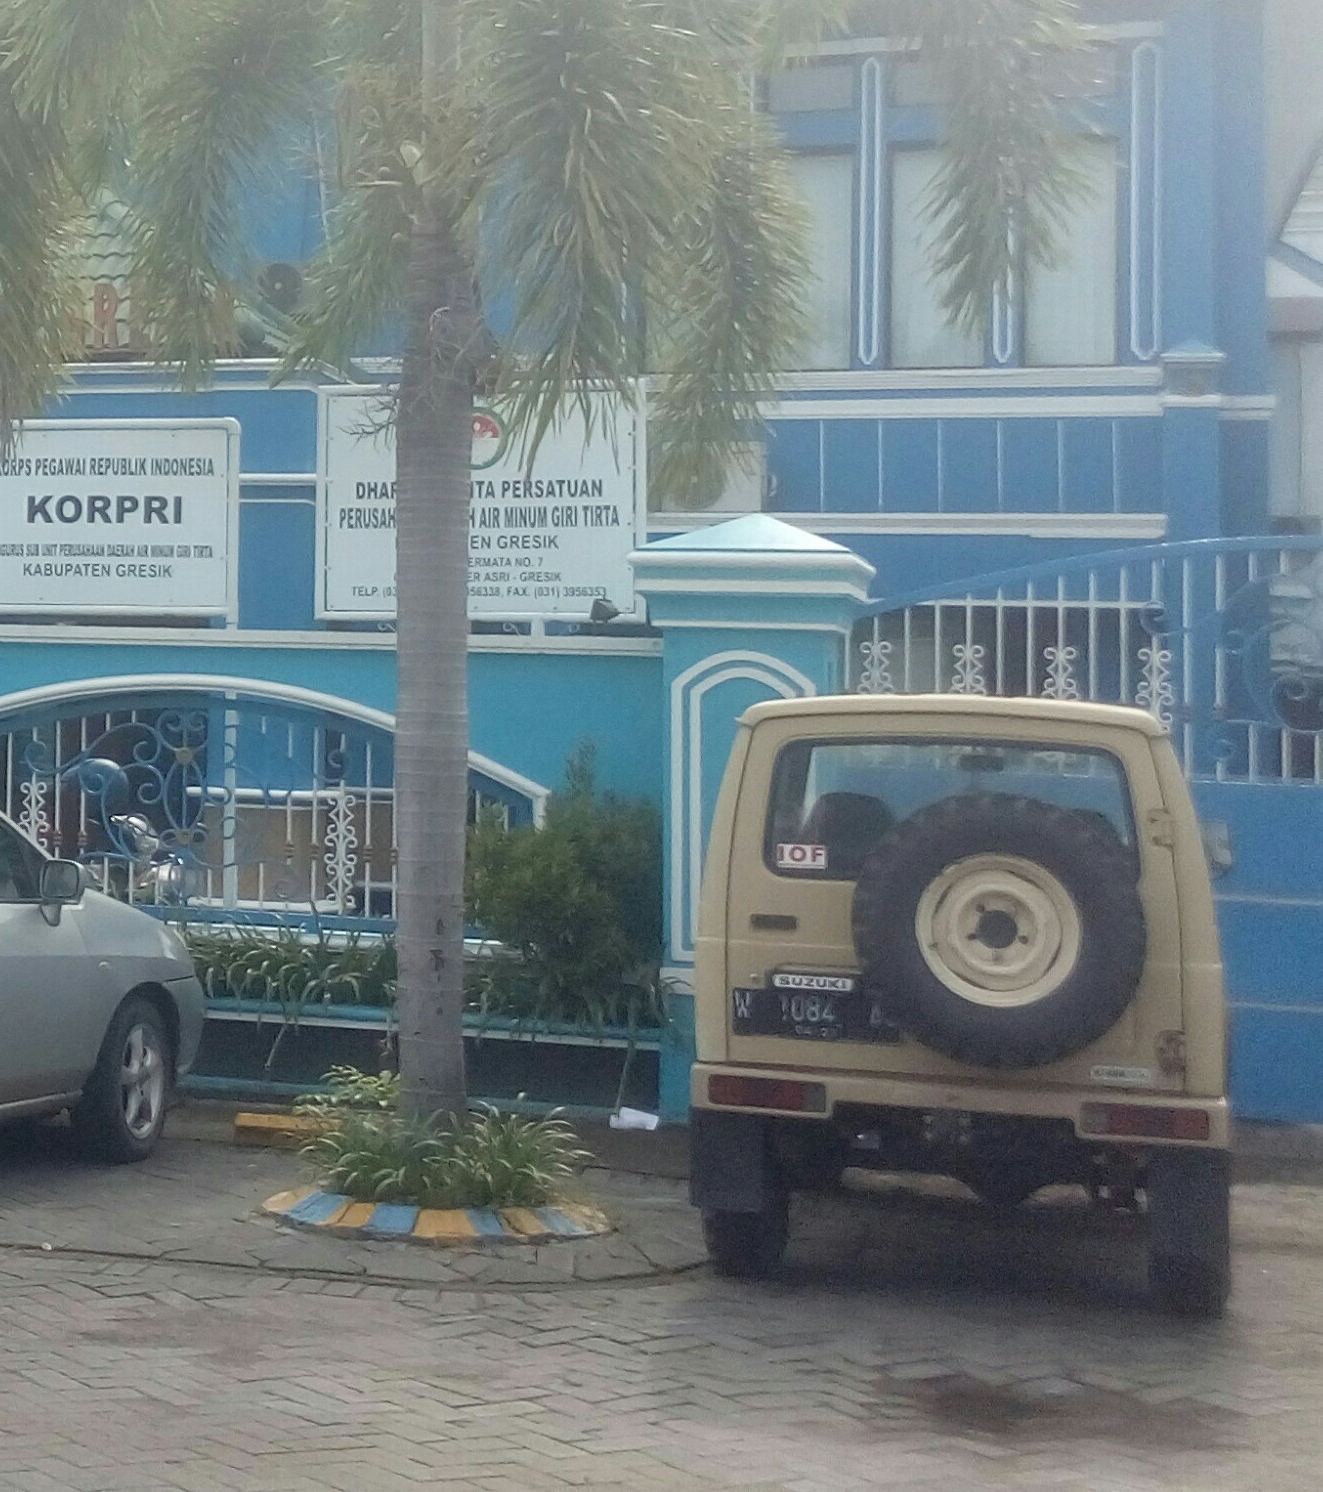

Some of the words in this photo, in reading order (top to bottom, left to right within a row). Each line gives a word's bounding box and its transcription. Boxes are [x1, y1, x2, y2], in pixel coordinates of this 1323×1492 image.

[35, 458, 85, 476] PEGAWAI
[89, 458, 147, 476] REPUBLIK
[151, 458, 214, 476] INDONESIA
[502, 479, 603, 498] PERSATUAN
[27, 495, 182, 524] KORPRI
[339, 508, 396, 529] PERUSAH
[479, 507, 500, 528] AIR
[504, 507, 547, 528] MINUM
[552, 506, 577, 527] GIRI
[583, 505, 619, 526] TIRTA
[497, 535, 559, 549] GRESIK
[468, 558, 511, 567] ERMATA
[23, 564, 110, 577] KABUPATEN
[116, 564, 172, 578] GRESIK
[484, 572, 510, 582] ASRI
[520, 572, 562, 582] GRESIK
[778, 975, 847, 990] SUZUKI
[734, 990, 751, 1018] W
